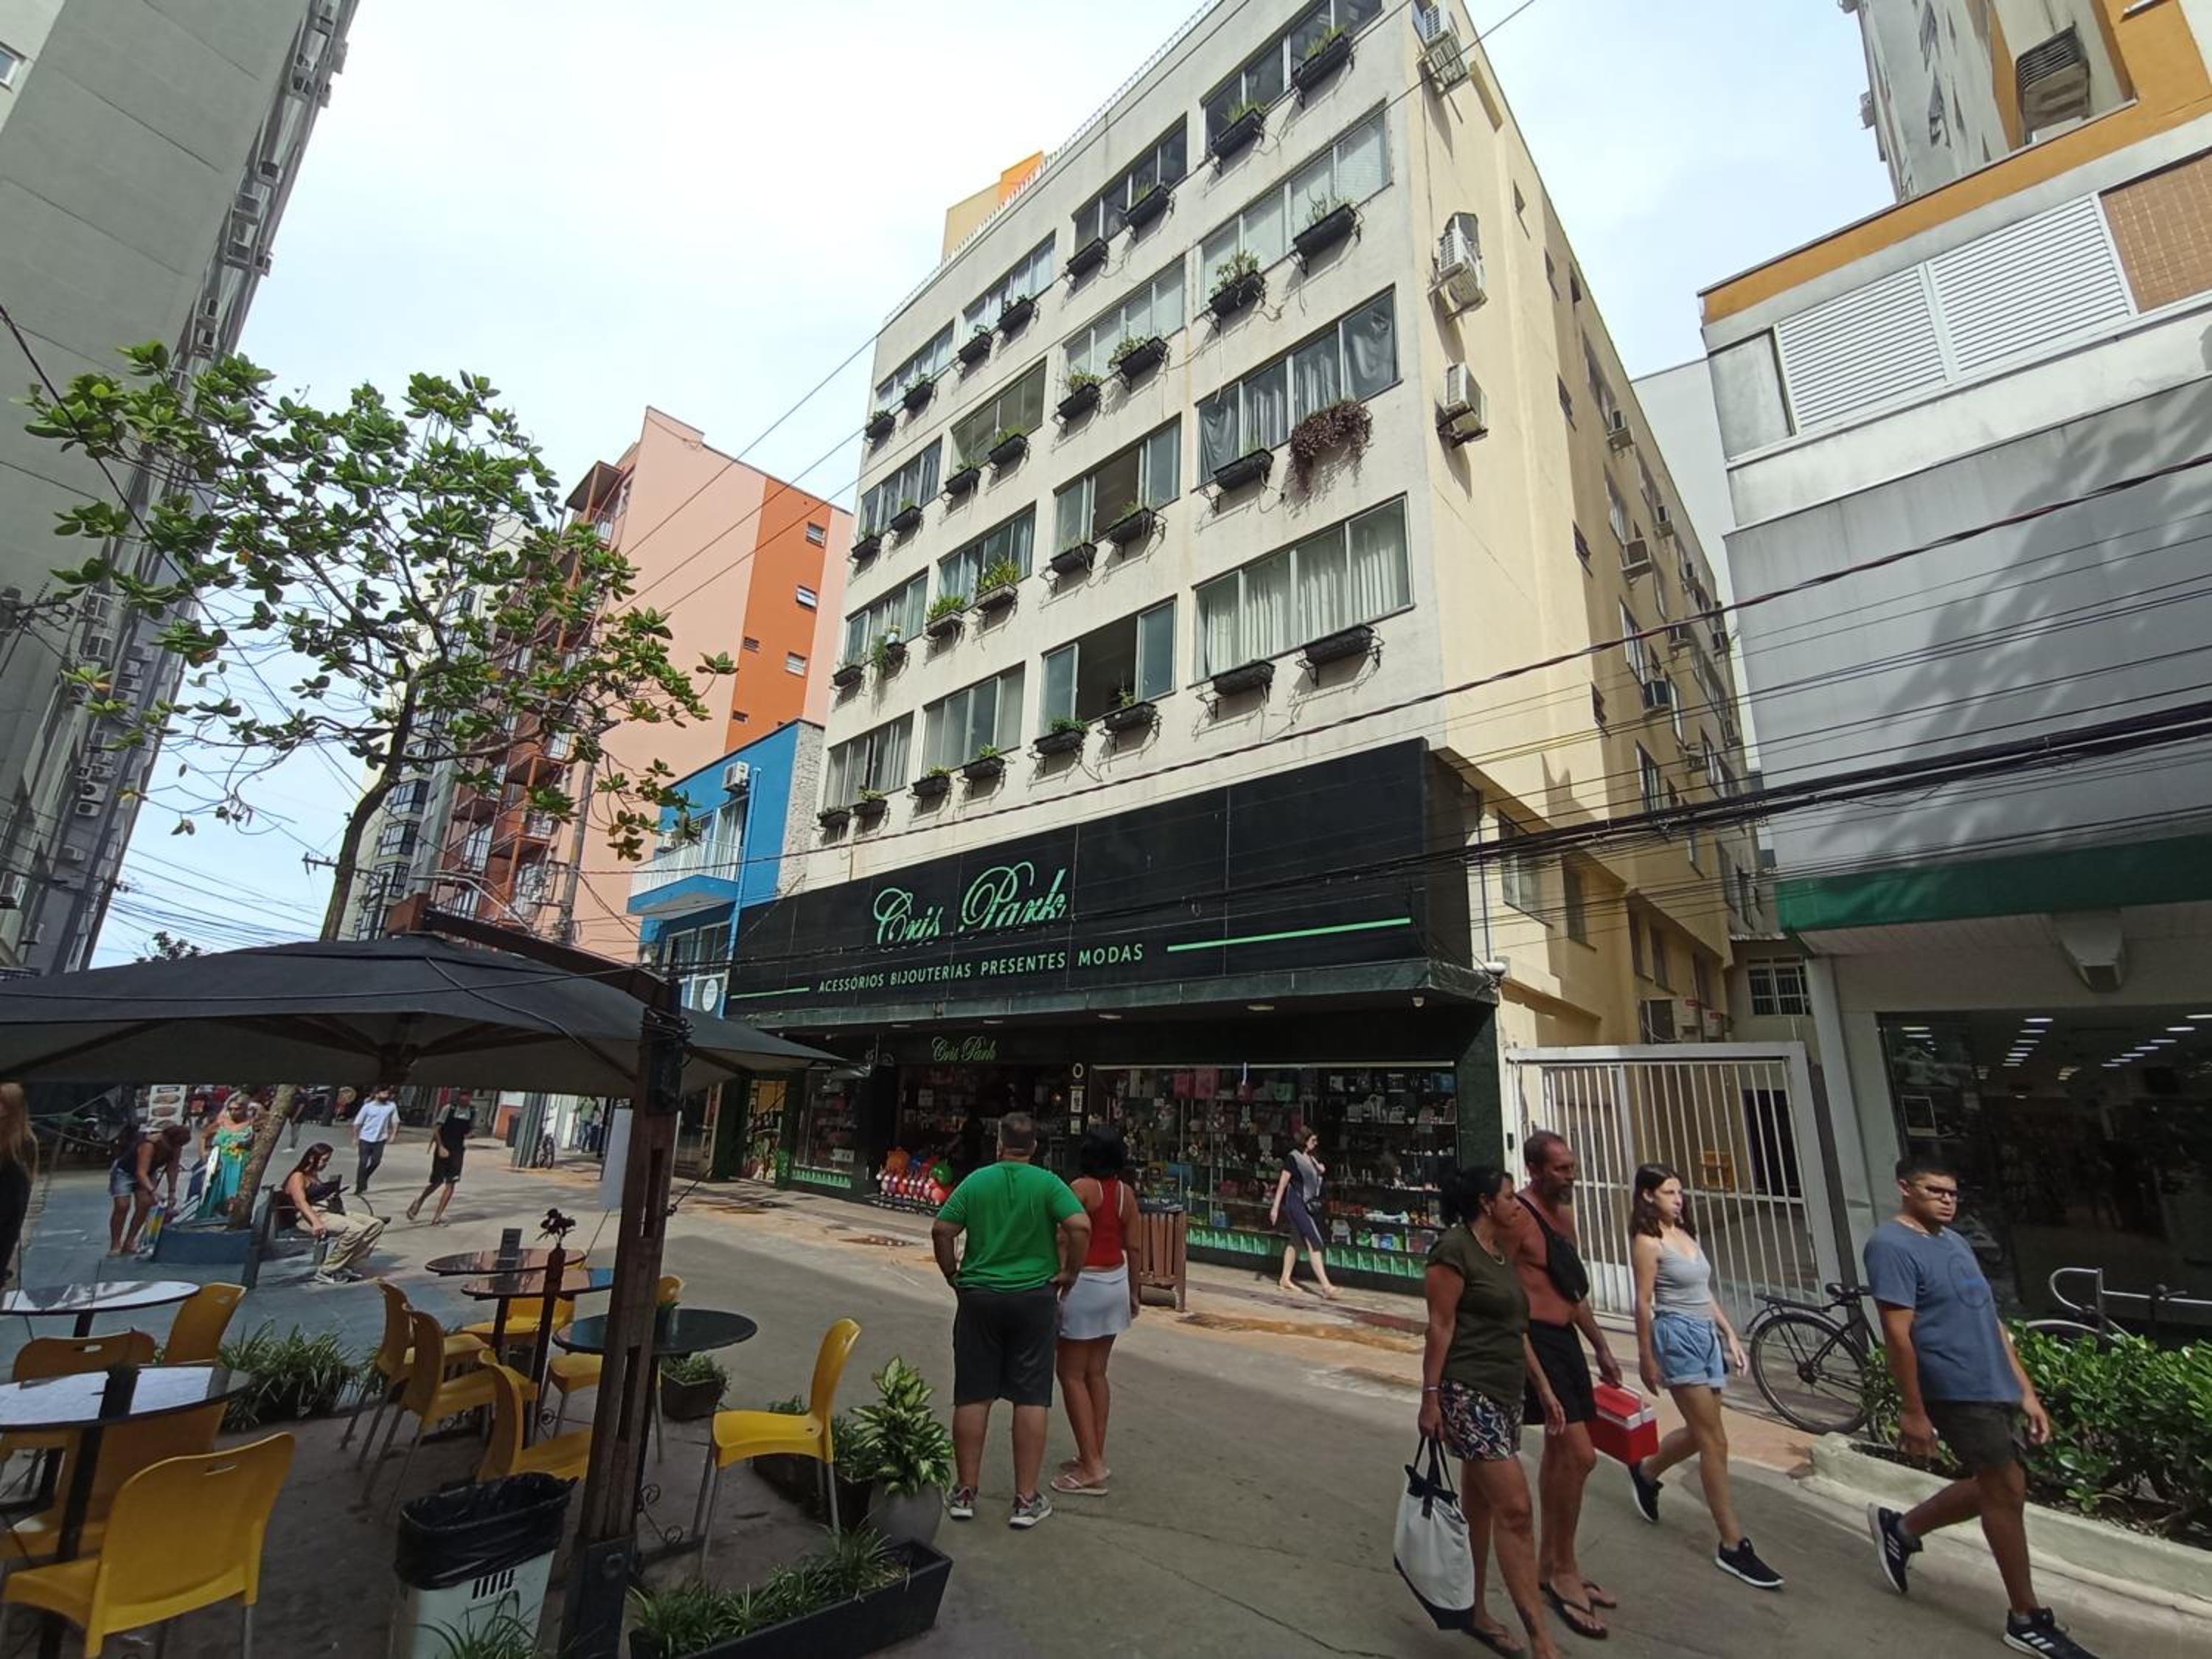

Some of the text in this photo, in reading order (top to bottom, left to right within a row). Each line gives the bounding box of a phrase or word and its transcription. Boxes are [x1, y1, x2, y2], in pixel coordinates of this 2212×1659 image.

[873, 861, 1066, 945] Cris Park
[818, 943, 1144, 992] ACESSORIOS BIJOUTERIAS PRESENTES MODAS
